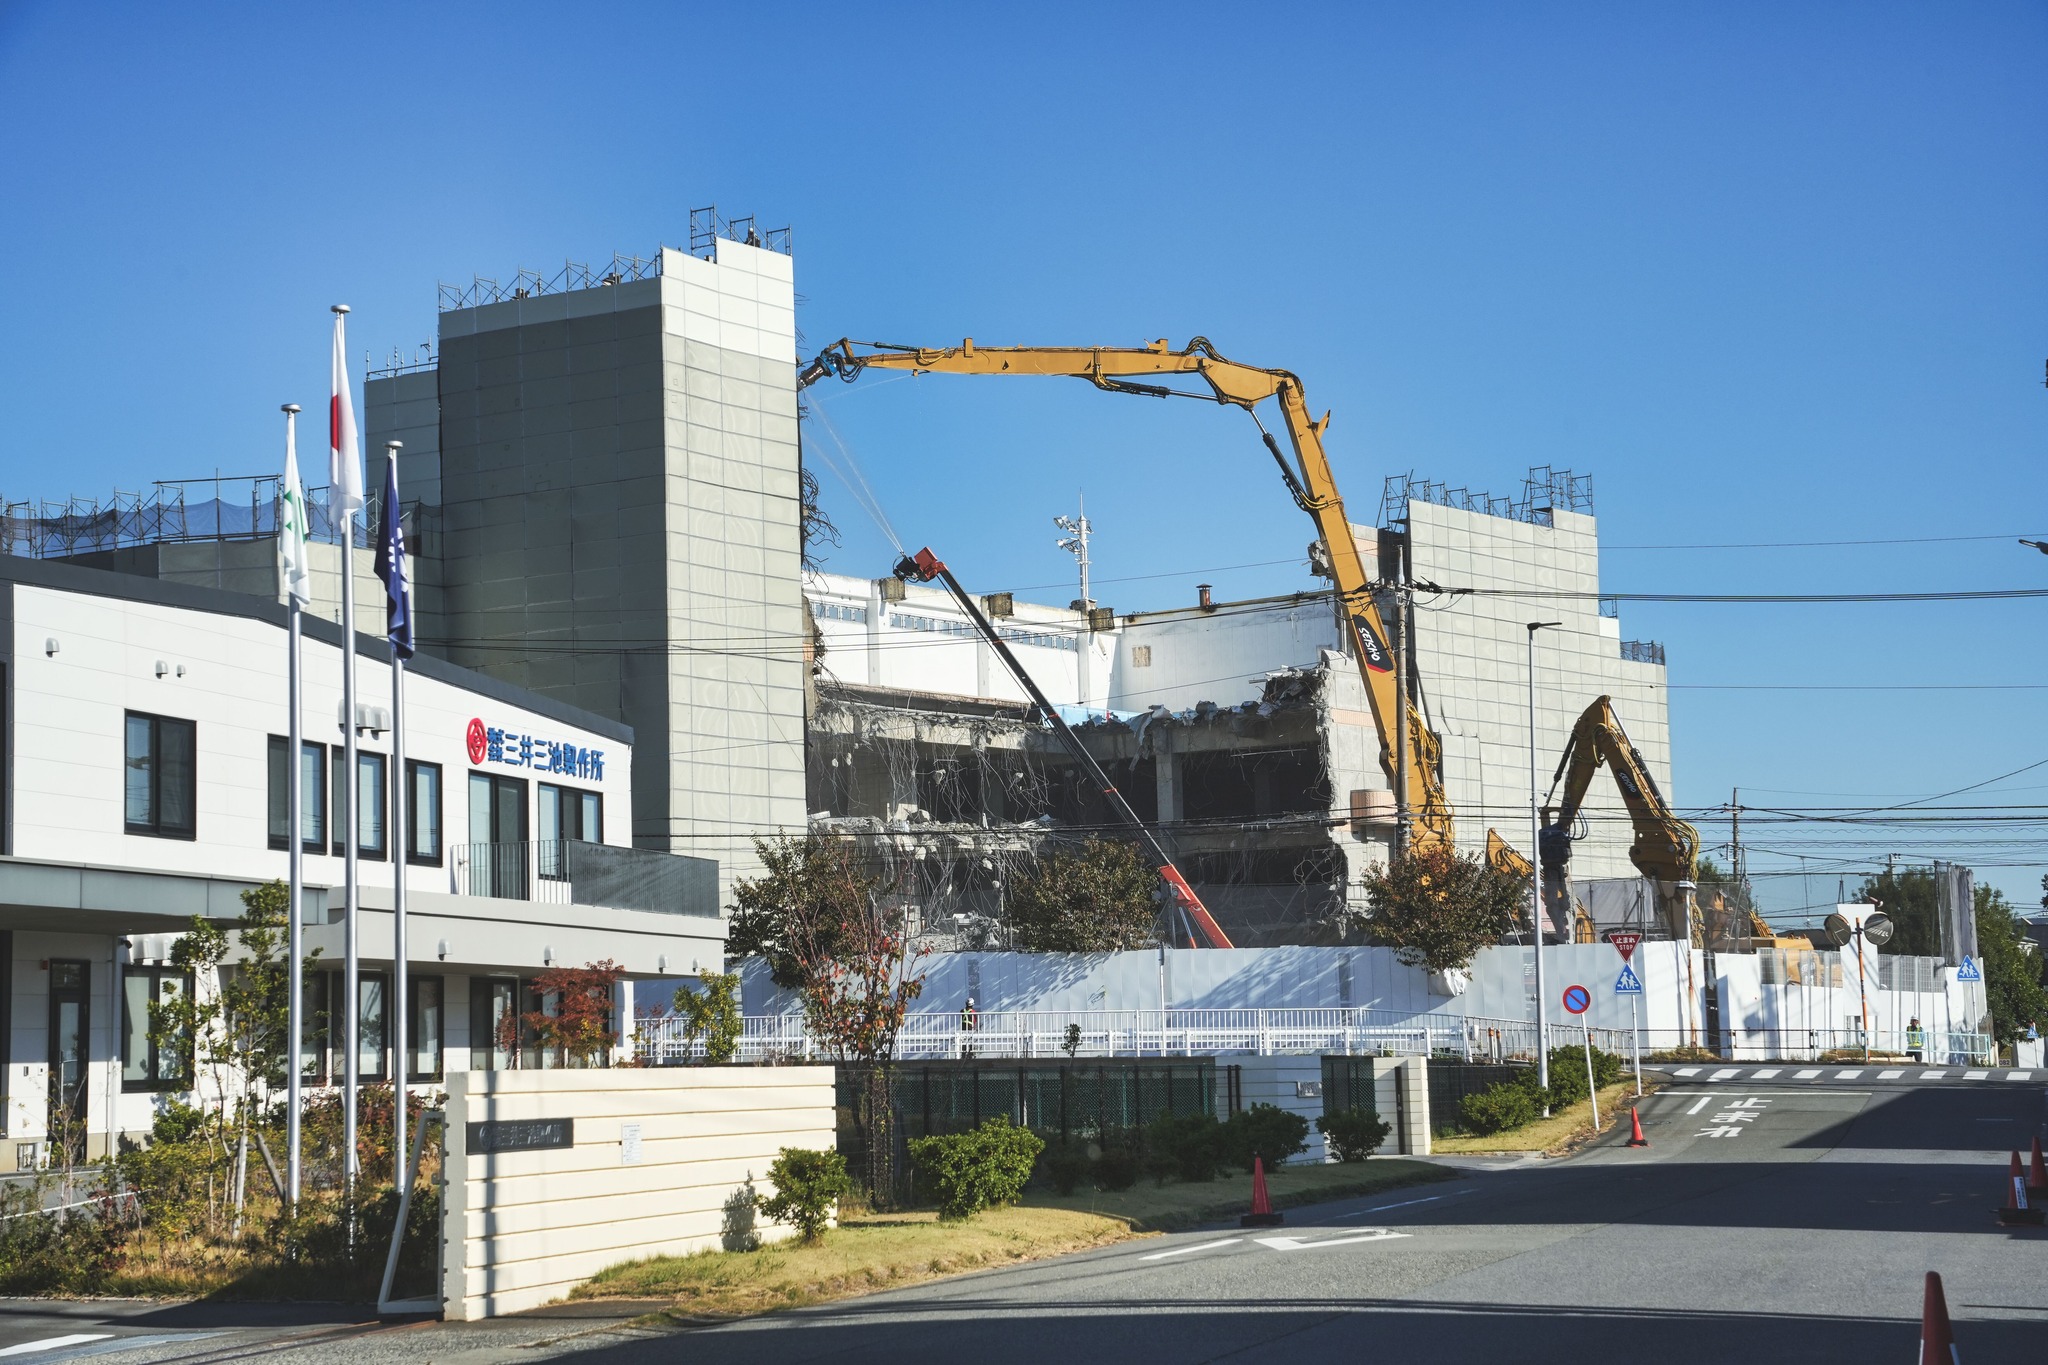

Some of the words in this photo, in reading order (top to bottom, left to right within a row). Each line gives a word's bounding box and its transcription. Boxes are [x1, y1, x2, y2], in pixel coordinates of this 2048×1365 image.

[1615, 936, 1636, 944] 止まれ
[1693, 1097, 1773, 1138] 止まれ
